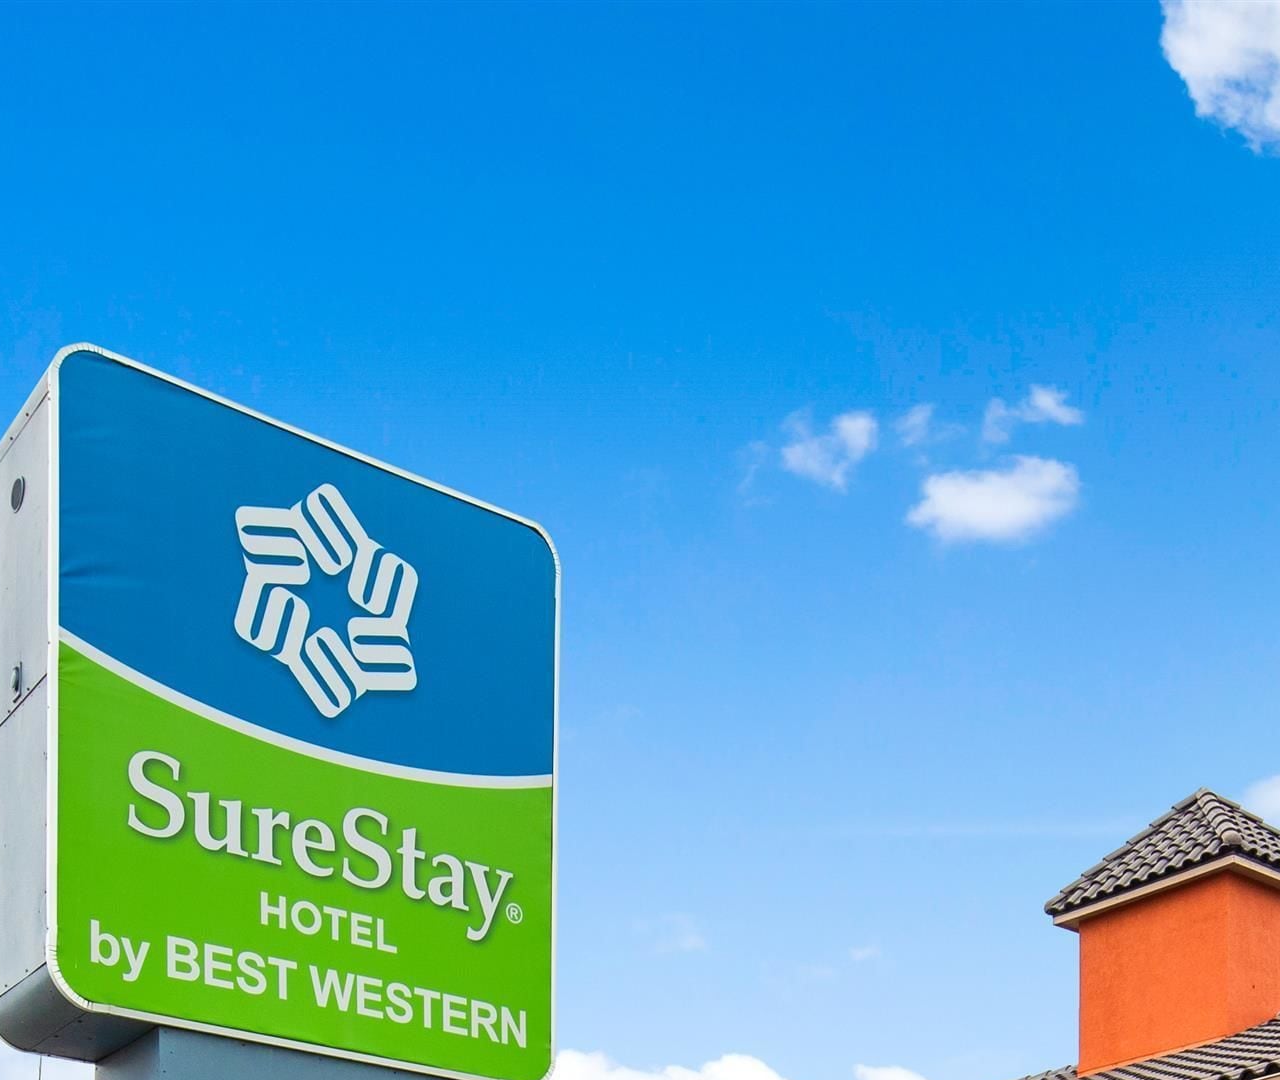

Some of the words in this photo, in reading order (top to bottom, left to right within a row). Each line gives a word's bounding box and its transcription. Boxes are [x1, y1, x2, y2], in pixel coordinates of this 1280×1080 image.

[259, 890, 398, 954] HOTEL
[88, 919, 151, 983] by
[166, 935, 298, 1001] BEST
[309, 964, 528, 1049] WESTERN
